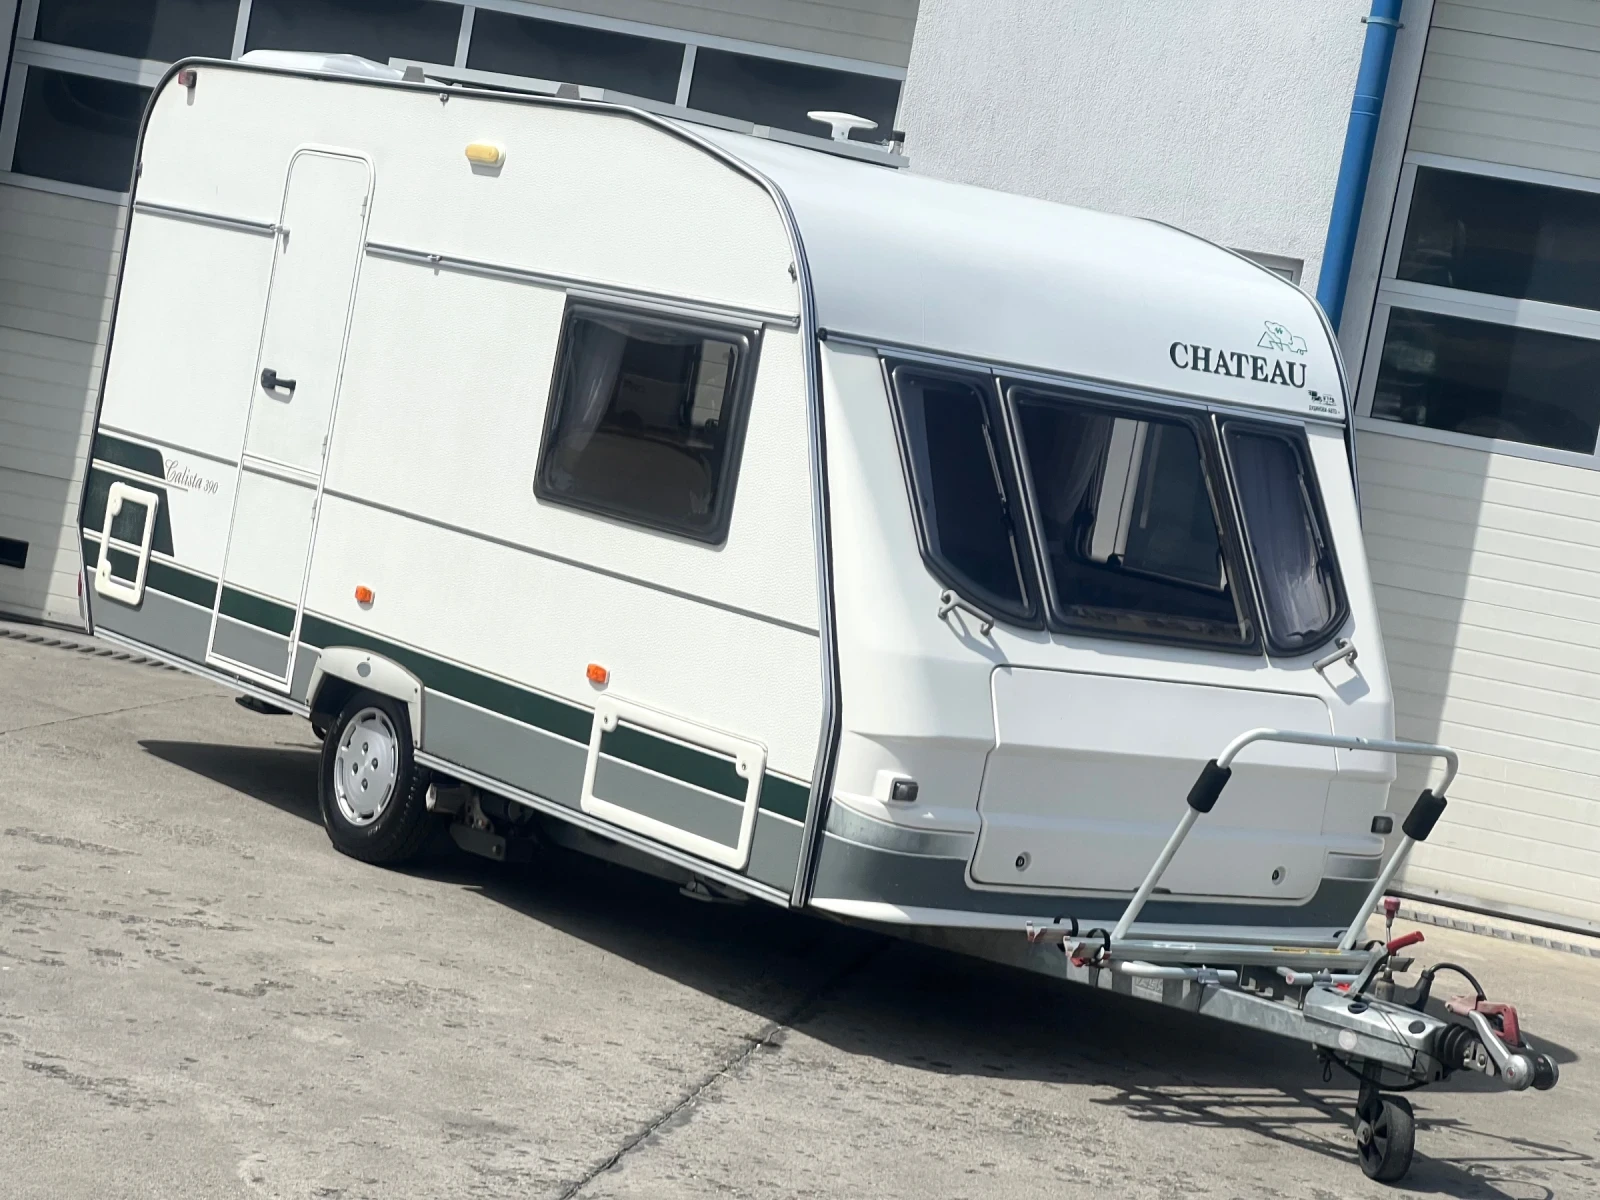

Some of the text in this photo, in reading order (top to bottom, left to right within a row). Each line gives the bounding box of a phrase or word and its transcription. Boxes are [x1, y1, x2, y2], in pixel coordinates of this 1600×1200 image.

[1170, 341, 1307, 388] CHATEAU
[165, 459, 219, 494] Calista 390
